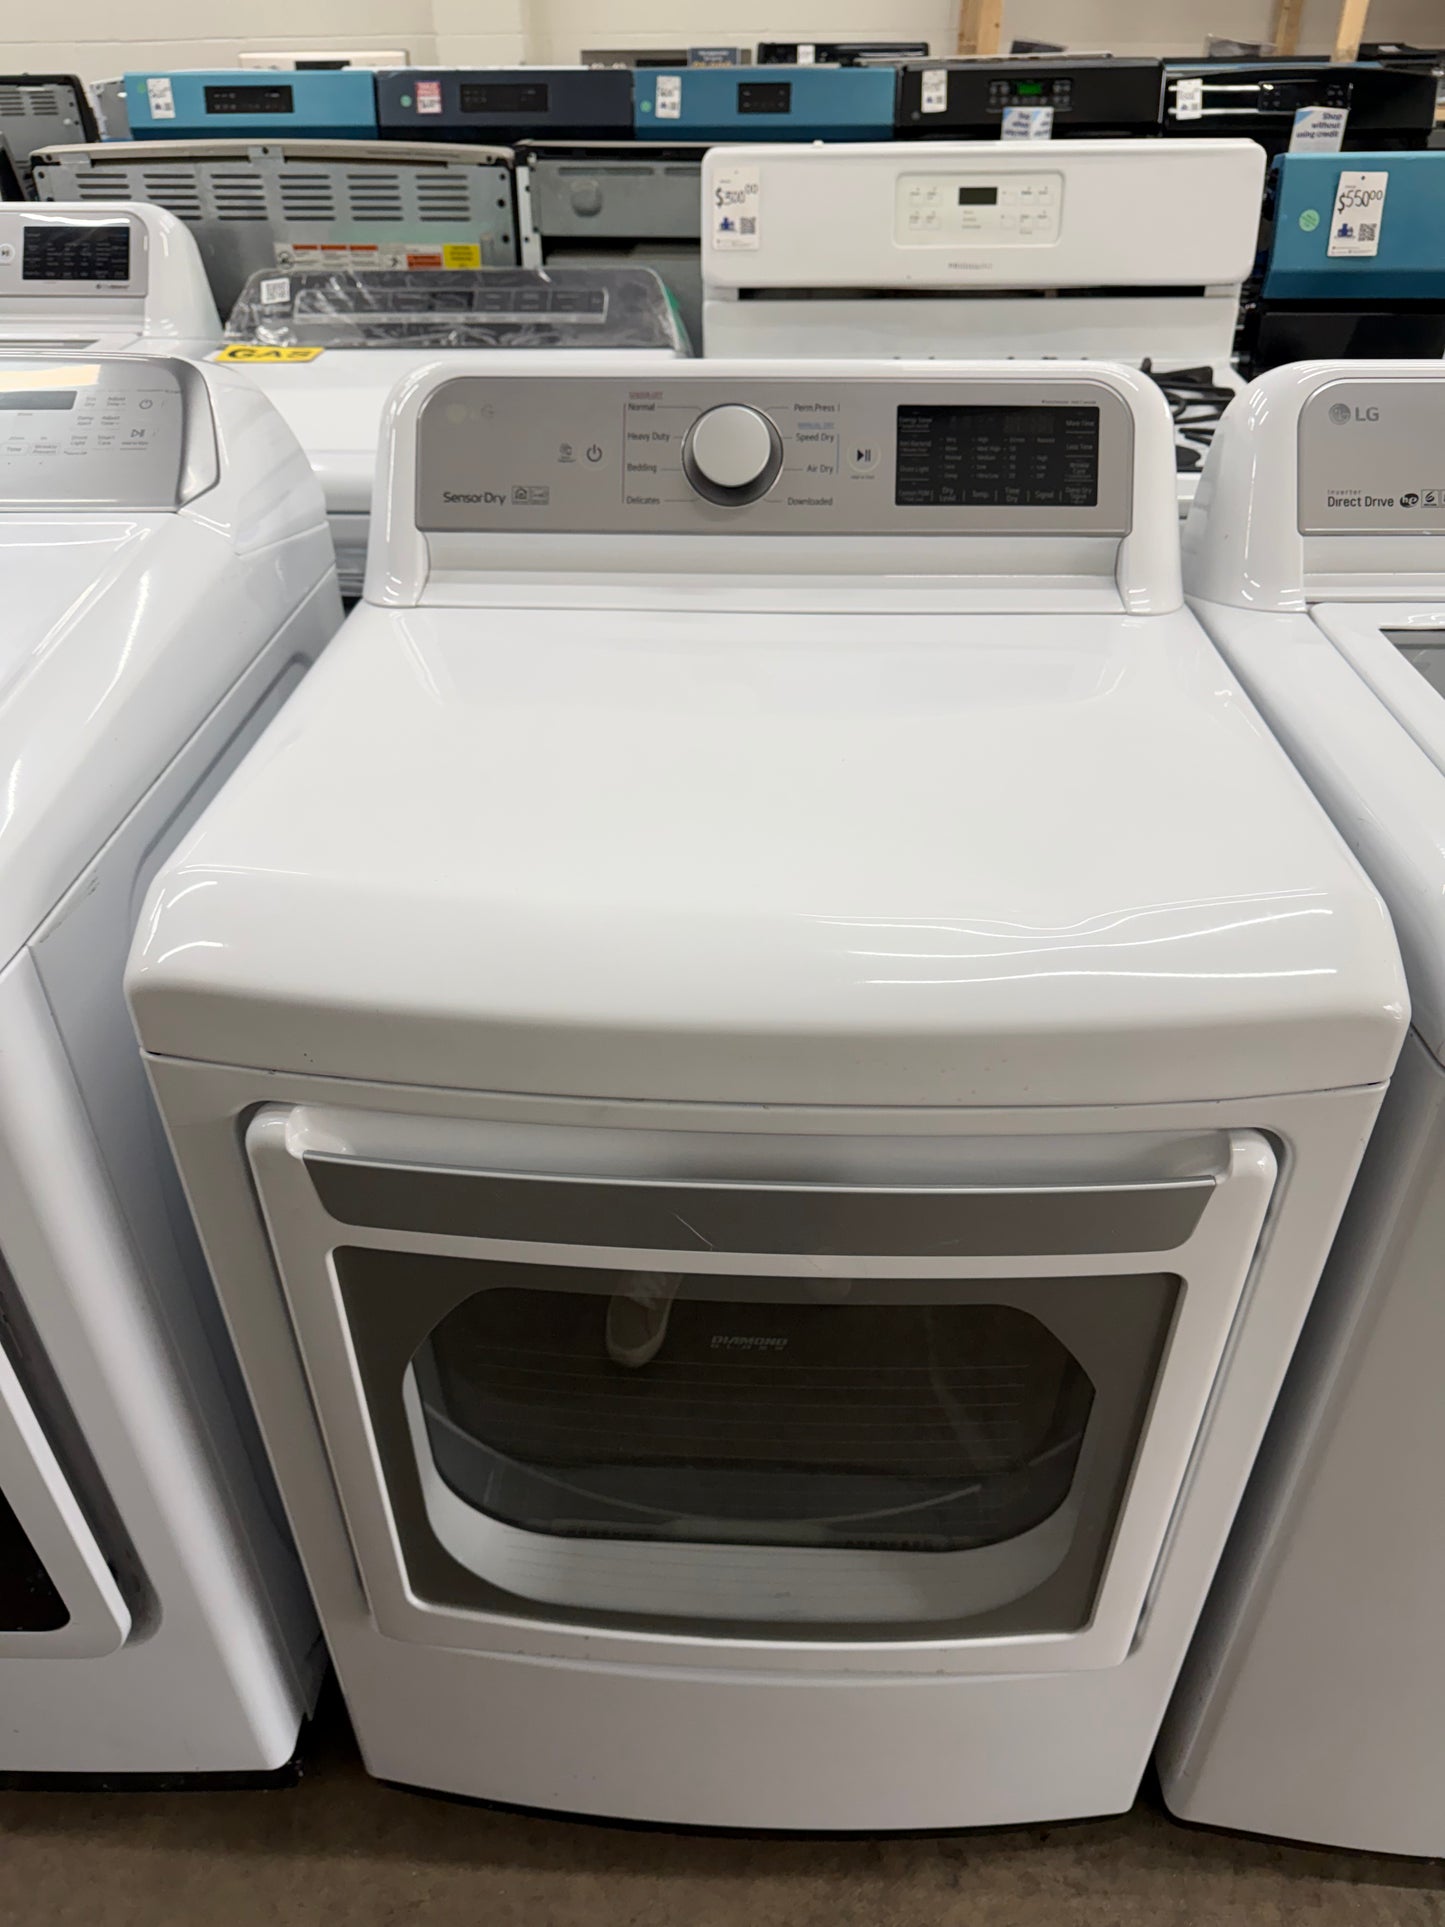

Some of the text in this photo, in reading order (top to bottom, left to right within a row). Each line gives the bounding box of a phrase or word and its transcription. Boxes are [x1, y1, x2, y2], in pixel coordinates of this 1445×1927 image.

[1322, 112, 1342, 120] Shop
[1311, 121, 1341, 129] without
[628, 403, 655, 411] Normal
[1355, 406, 1380, 422] LG
[627, 432, 670, 442] Heavy Duty
[795, 432, 834, 443] Speed Dry
[627, 463, 657, 474] Bedding
[807, 464, 833, 475] Air Dry
[626, 496, 660, 505] Delicates
[787, 496, 833, 506] Downloaded
[1327, 496, 1394, 507] Direct Drive
[711, 1335, 789, 1346] DIAMOND
